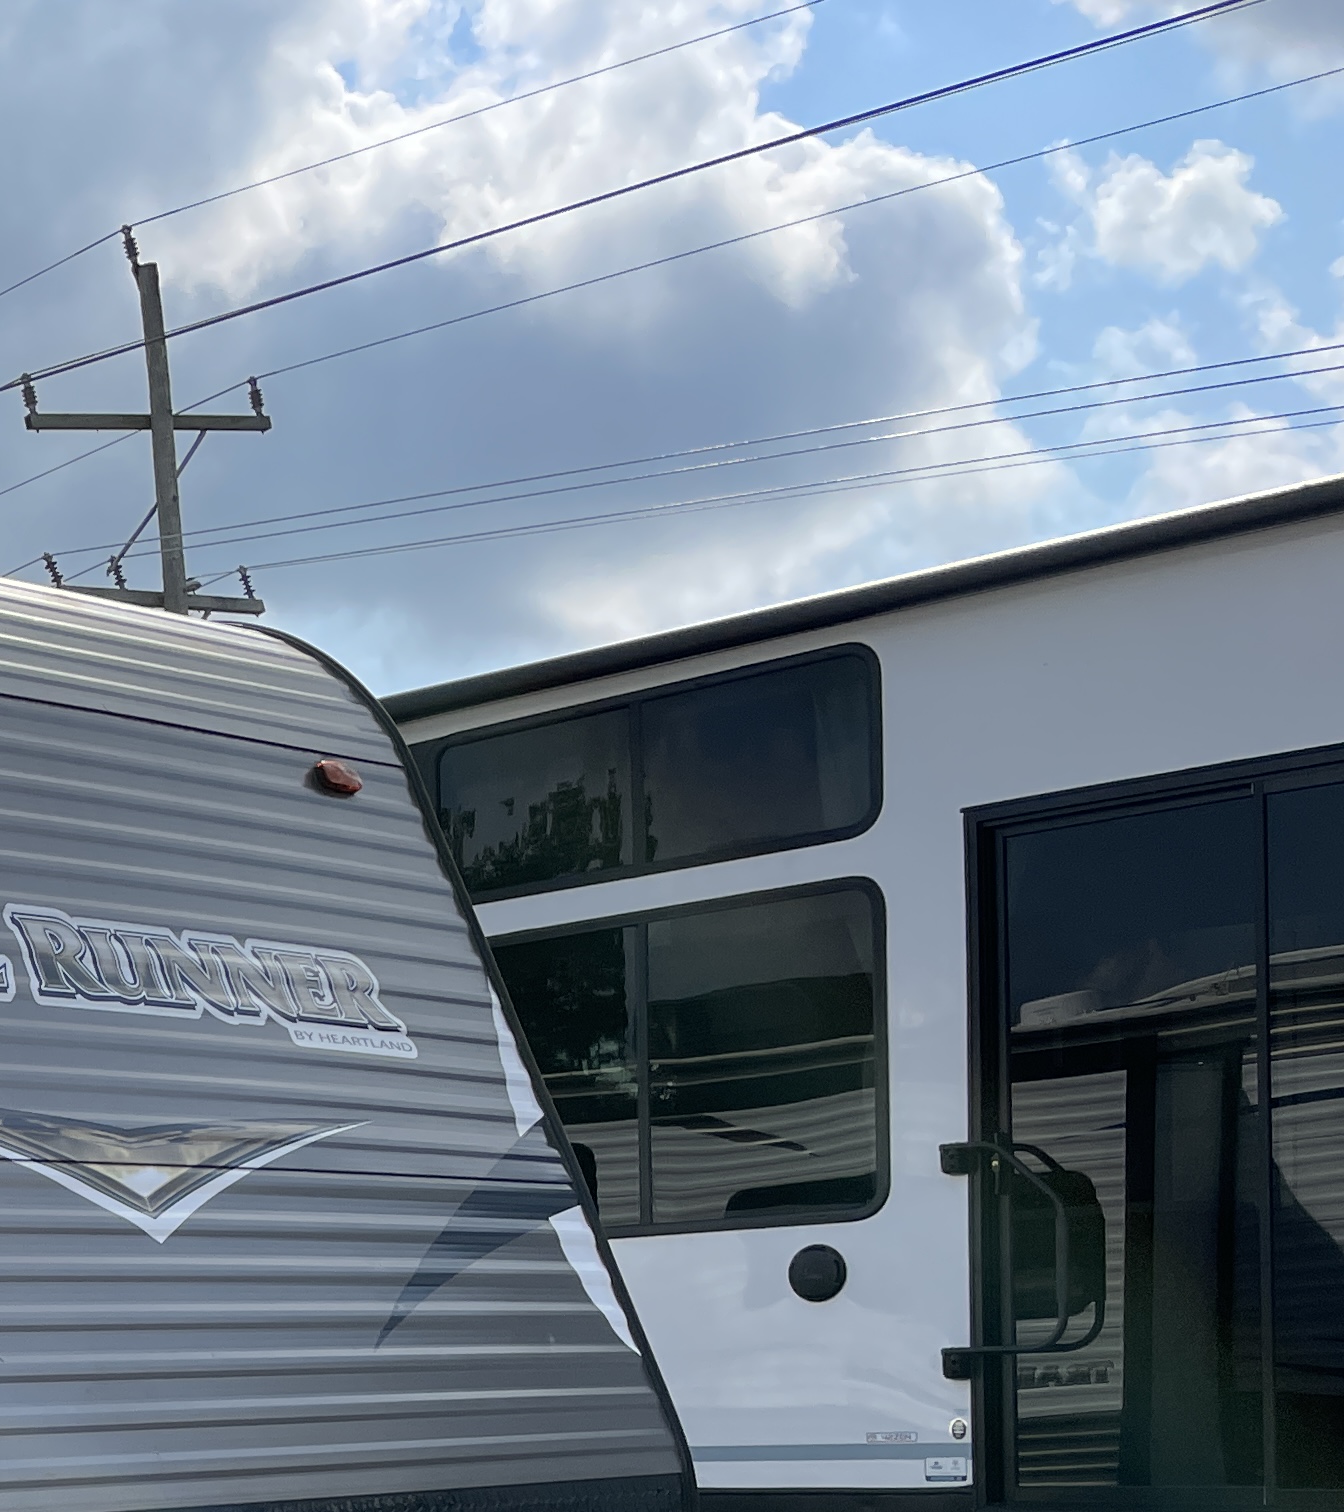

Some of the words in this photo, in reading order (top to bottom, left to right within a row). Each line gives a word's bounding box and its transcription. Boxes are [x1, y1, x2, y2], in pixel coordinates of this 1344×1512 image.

[9, 911, 408, 1033] RUNNER
[293, 1029, 314, 1041] BY
[318, 1032, 413, 1052] HEARTLAND
